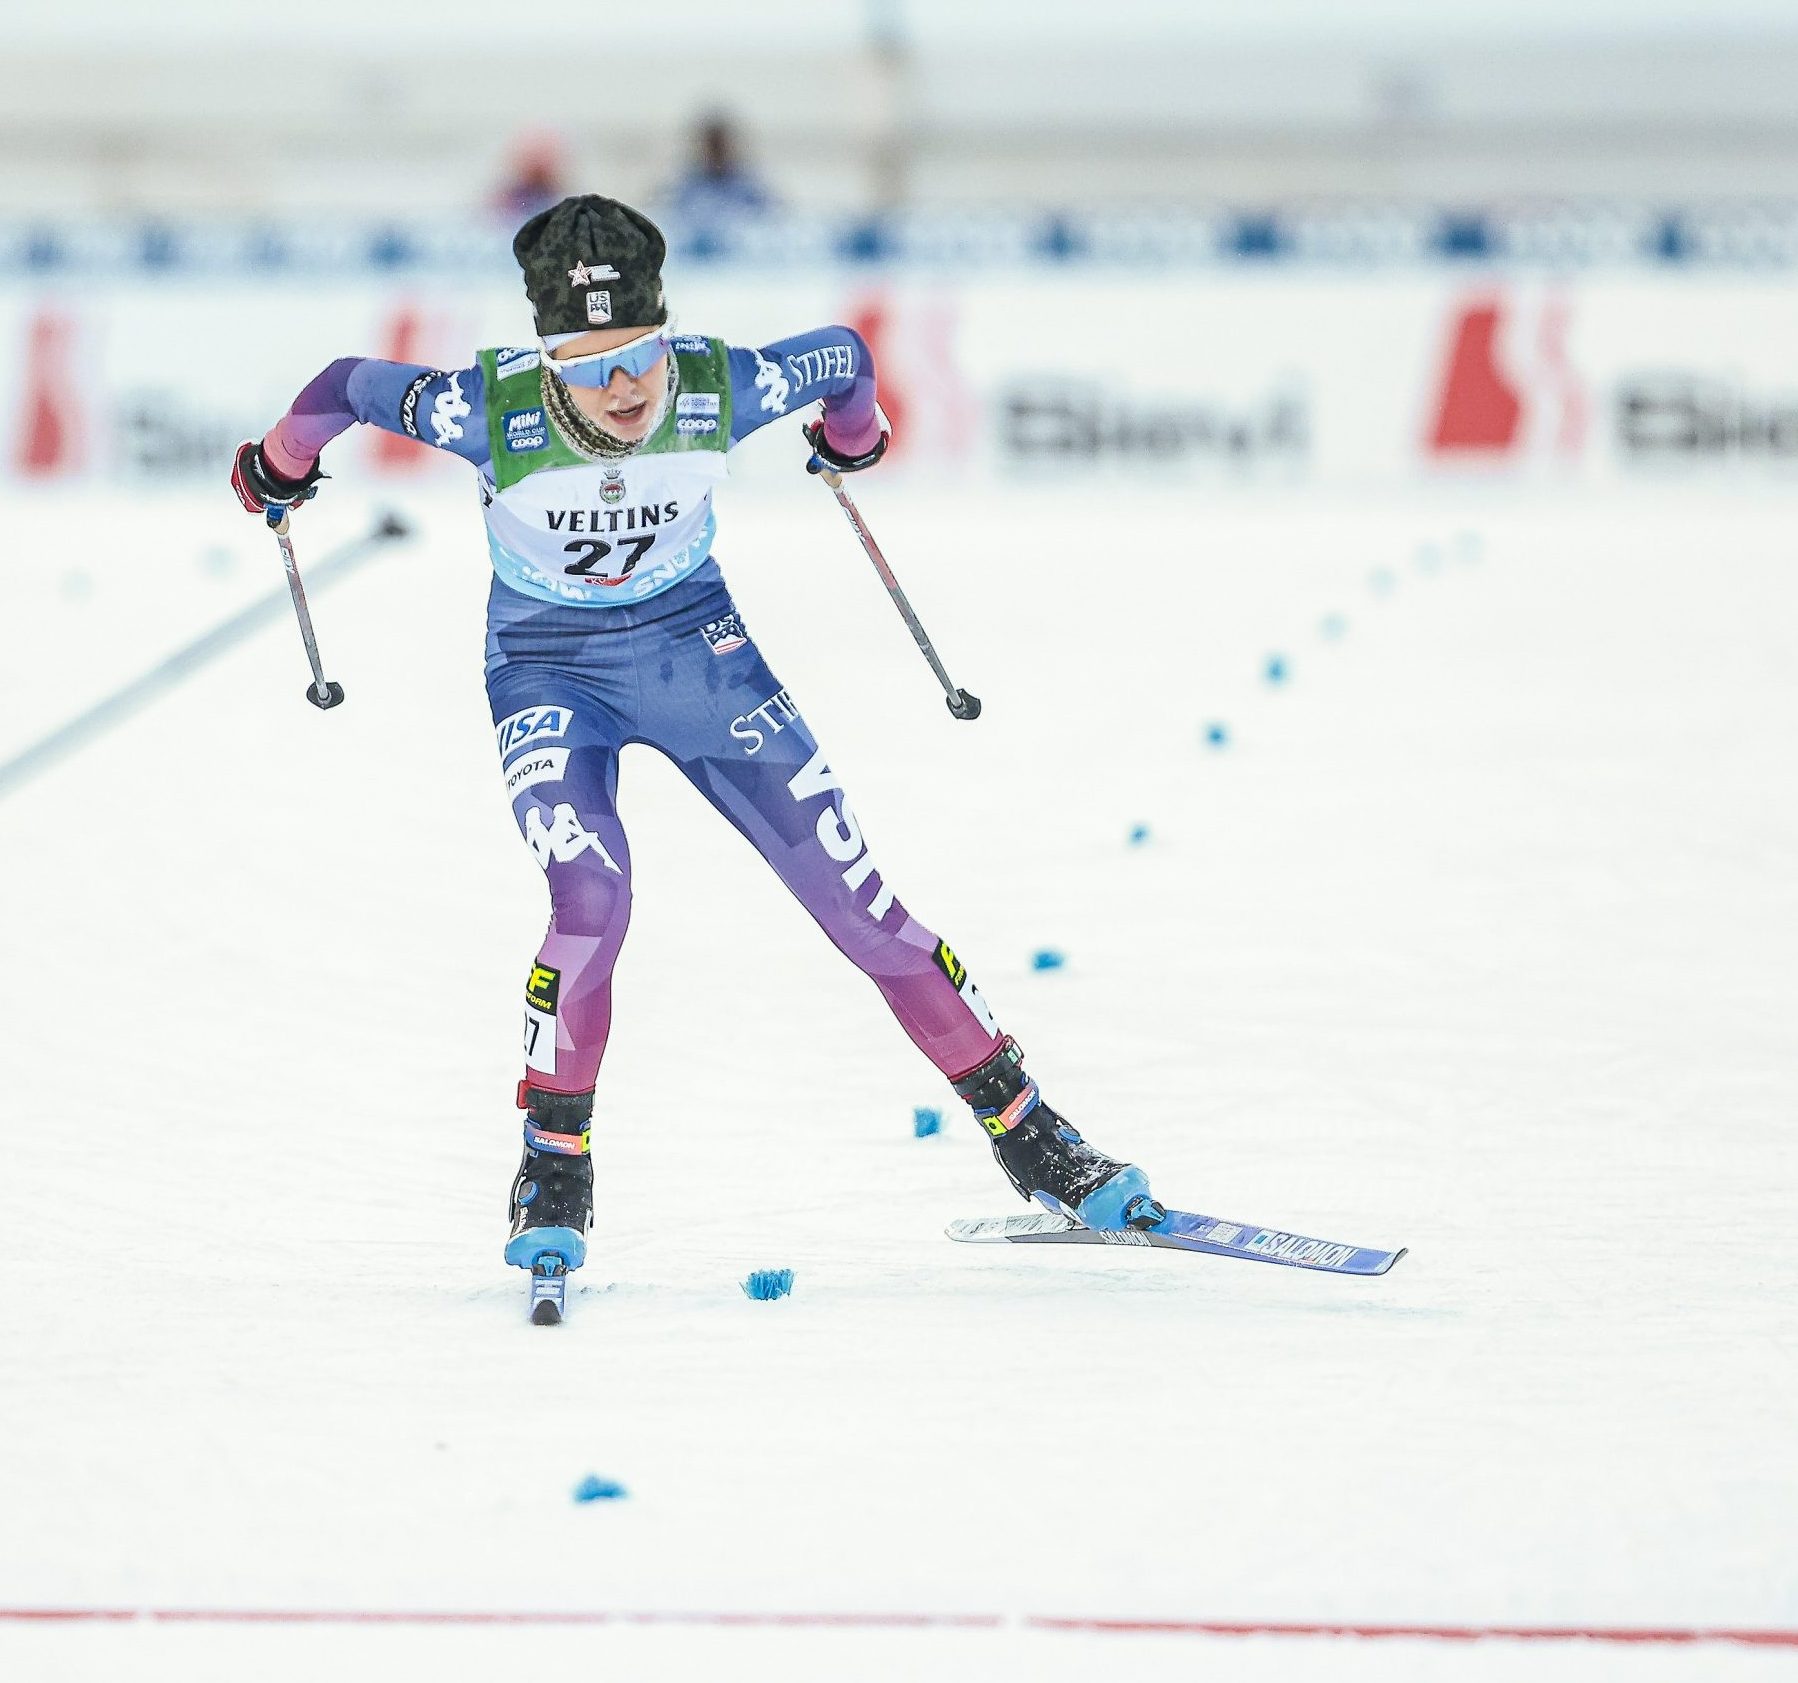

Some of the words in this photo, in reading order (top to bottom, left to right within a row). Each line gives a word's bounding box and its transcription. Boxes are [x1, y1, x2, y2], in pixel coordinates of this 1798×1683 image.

[589, 292, 608, 303] US
[787, 345, 855, 394] STIFEL
[511, 436, 544, 449] coop
[546, 500, 679, 532] VELTINS
[563, 532, 656, 578] 27
[508, 759, 554, 790] TOYOTA
[1009, 1089, 1036, 1122] SALOMON
[533, 1136, 575, 1150] SALOMON
[1101, 1230, 1152, 1246] SALOMON
[1265, 1233, 1358, 1267] SALOMON
